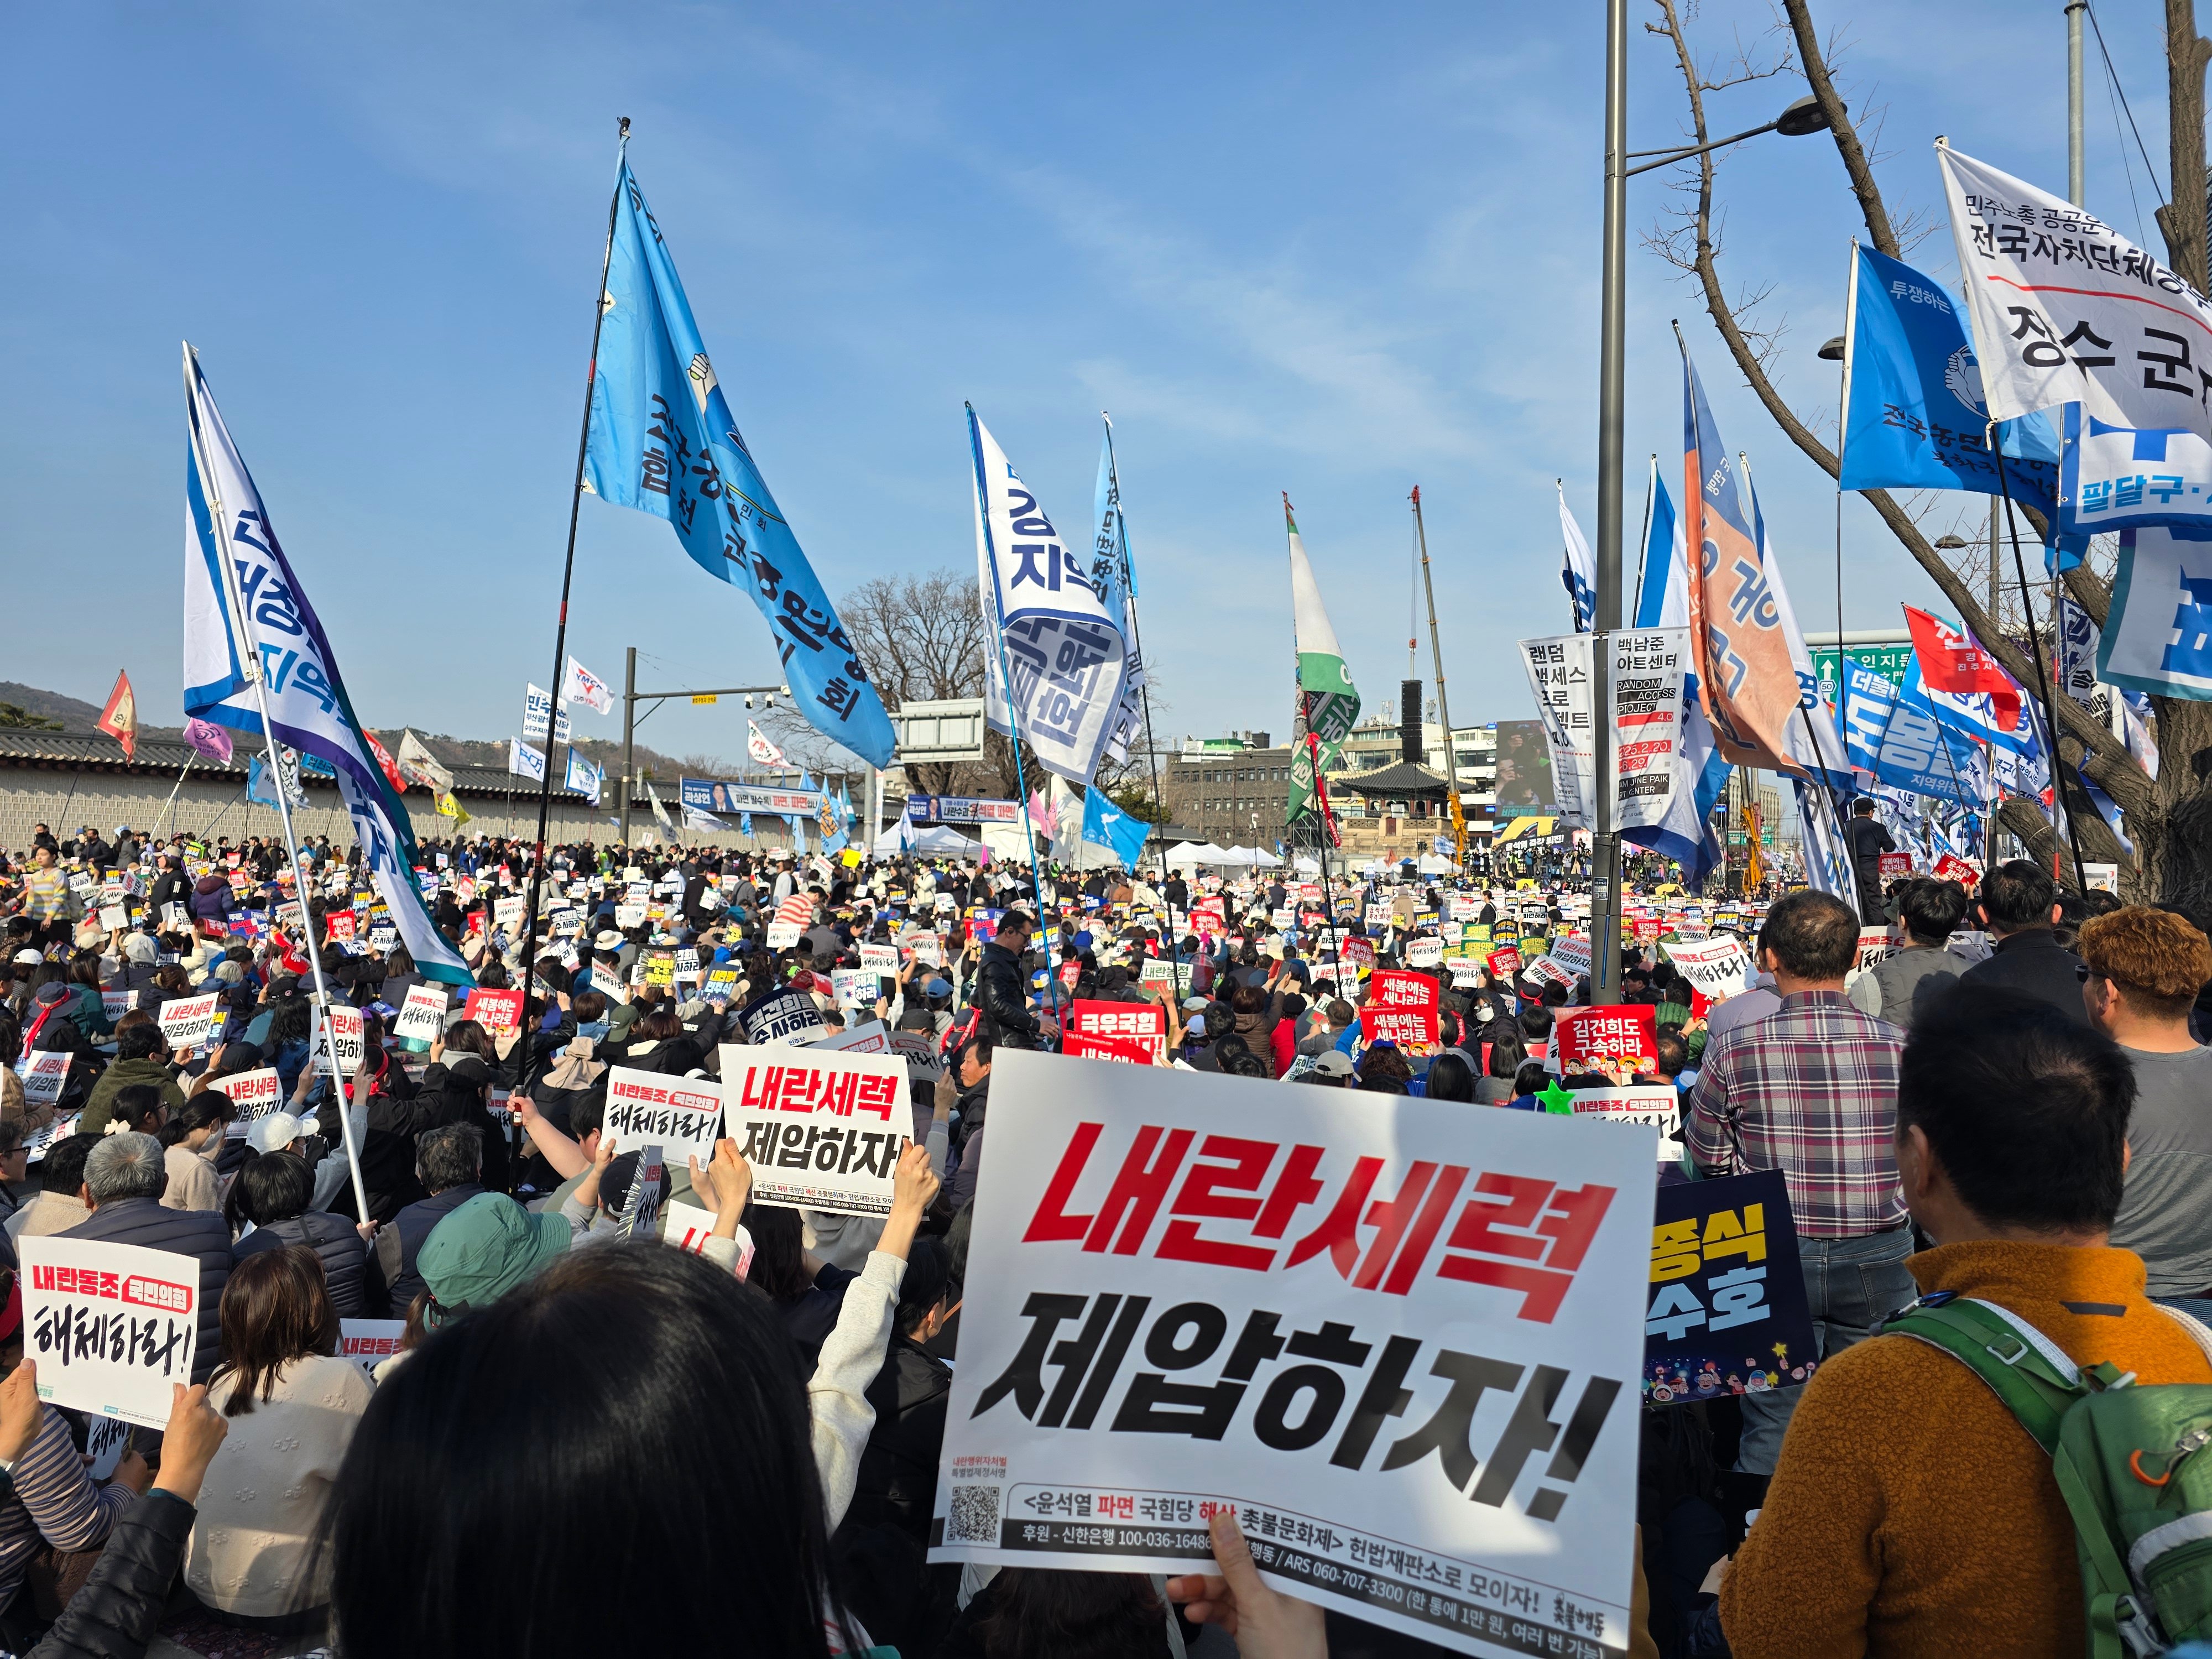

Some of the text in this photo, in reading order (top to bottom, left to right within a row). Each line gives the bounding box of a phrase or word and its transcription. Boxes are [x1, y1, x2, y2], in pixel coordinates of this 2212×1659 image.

[1965, 194, 2037, 227] 민주노총
[1890, 280, 1951, 314] 투쟁하는
[1529, 643, 1565, 665] 랜덤
[1618, 637, 1665, 653] 백남준
[1617, 653, 1677, 671] 아트센터
[577, 673, 602, 690] YMCA
[1617, 678, 1661, 690] RANDOM
[1657, 712, 1673, 721] 4.0
[1552, 731, 1569, 747] 4.0
[1650, 775, 1668, 784] PAIK
[1911, 773, 1971, 799] 지역위원회
[684, 792, 711, 804] 곽상언
[735, 794, 749, 804] 파면
[773, 795, 789, 807] 파면,
[791, 796, 817, 809] 파면입니
[998, 805, 1015, 818] 파면!
[1546, 834, 1564, 844] 퇴진!
[1678, 924, 1707, 932] 내란세력
[854, 973, 876, 988] 해체
[1537, 959, 1574, 988] 내란세력
[855, 986, 878, 1001] 하라
[1382, 978, 1431, 995] 새봄에는
[475, 997, 517, 1011] 새봄에는
[747, 993, 819, 1033] 김건희를
[165, 1006, 213, 1027] 내란세력
[473, 1010, 512, 1025] 새나라로
[1081, 1012, 1157, 1034] 극우국힘
[1373, 1013, 1426, 1028] 새봄에는
[162, 1017, 211, 1039] 제압하자!
[1376, 1027, 1428, 1043] 새나라로
[1573, 1018, 1641, 1038] 김건희도
[788, 1036, 806, 1046] 민주당
[1575, 1037, 1642, 1057] 구속하라
[225, 1075, 278, 1100] 내란세력
[613, 1081, 717, 1112] 내란동조 국민의힘
[740, 1066, 899, 1121] 내란세력
[1574, 1099, 1670, 1113] 내란동조 국민의힘
[608, 1102, 717, 1144] 해체하라!
[1022, 1121, 1618, 1324] 내란세력
[1648, 1202, 1767, 1283] 종식
[33, 1265, 189, 1311] 내란동조 국민의힘
[1646, 1266, 1770, 1341] 수호
[33, 1303, 192, 1378] 해체하라!
[969, 1292, 1623, 1522] 제압하자!
[952, 1456, 1007, 1468] 내란행위자처벌
[951, 1467, 1006, 1479] 특별법제정서명
[1024, 1492, 1540, 1614] <윤석열 파면 국힘당 촛불문화제> 헌법재판소로 모이자!
[1022, 1524, 1050, 1541] 후원
[1062, 1526, 1115, 1546] 신한은행
[1118, 1530, 1213, 1550] 100-036-16486
[1246, 1540, 1276, 1564] 행동
[1285, 1553, 1312, 1575] ARS
[1312, 1562, 1404, 1603] 060-707-3300
[1405, 1590, 1430, 1613] (한
[1430, 1597, 1458, 1623] 통에
[1460, 1606, 1485, 1631] 1만
[1489, 1615, 1508, 1640] 원,
[1512, 1621, 1544, 1647] 여러
[1547, 1631, 1564, 1652] 번
